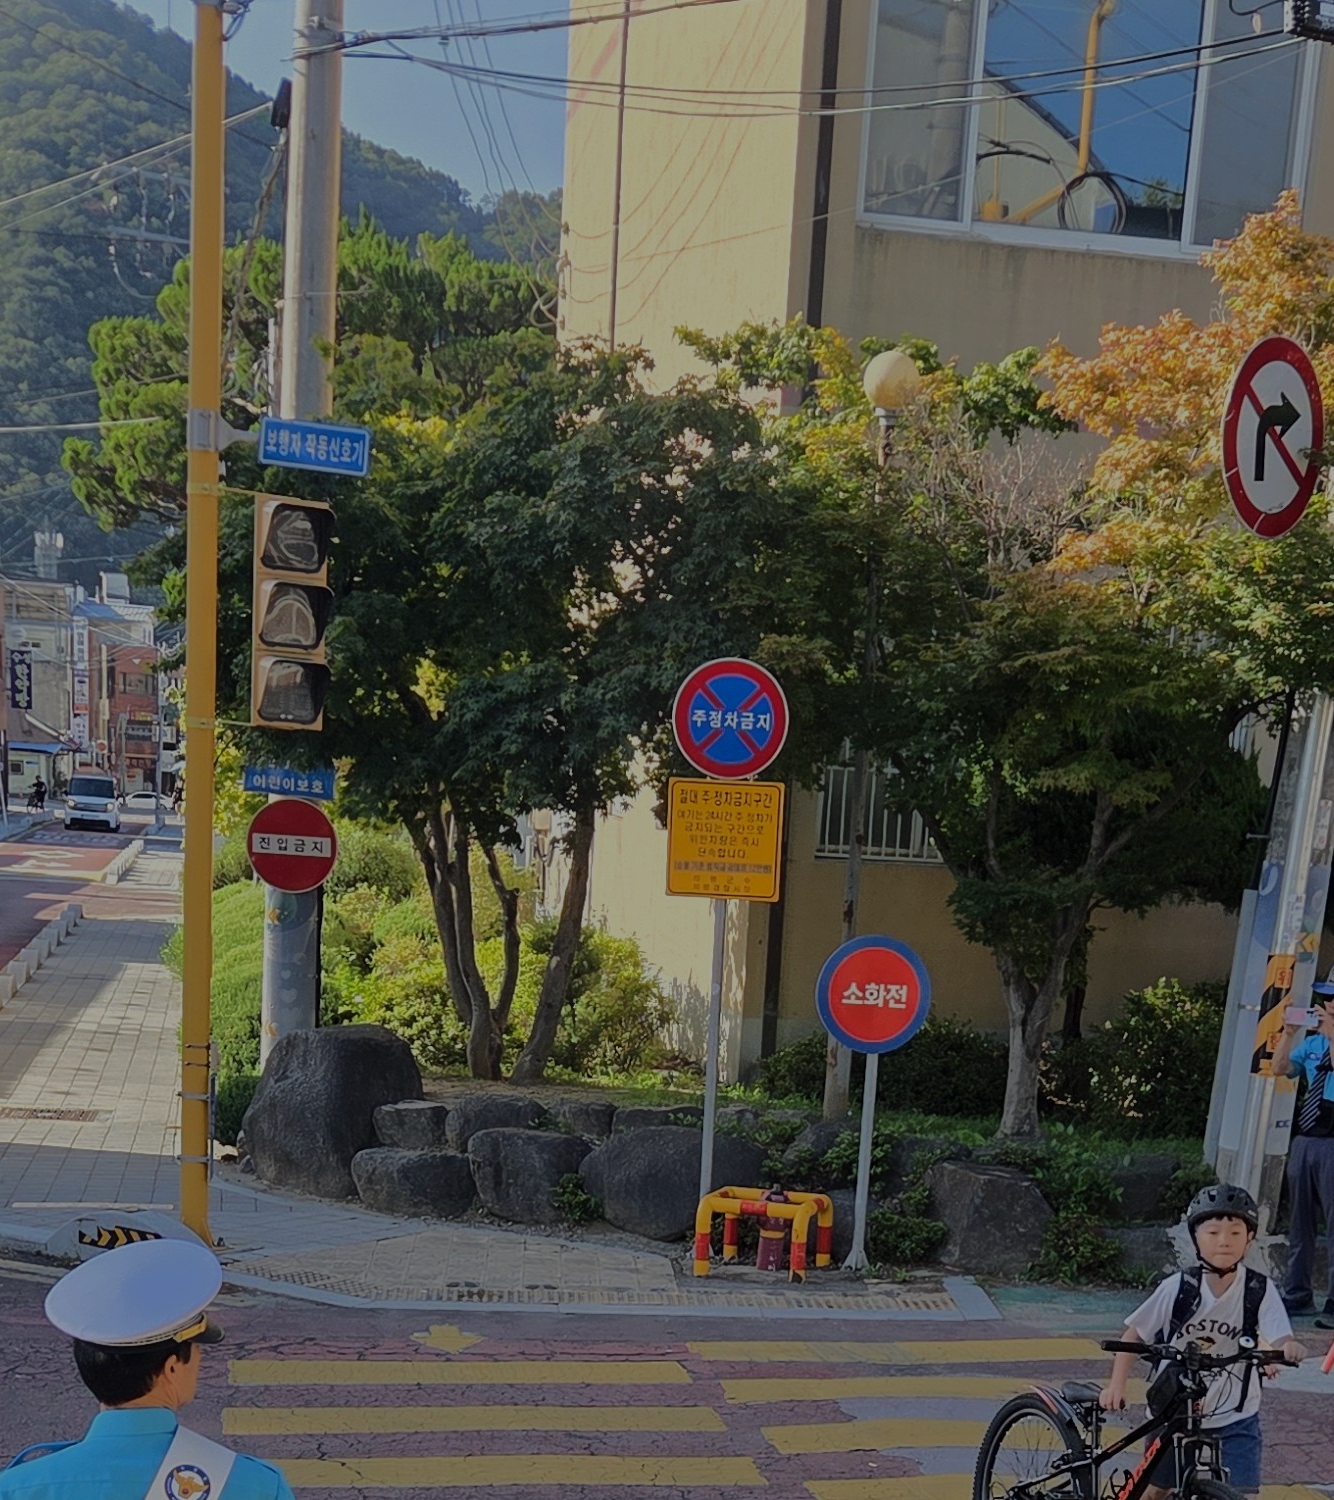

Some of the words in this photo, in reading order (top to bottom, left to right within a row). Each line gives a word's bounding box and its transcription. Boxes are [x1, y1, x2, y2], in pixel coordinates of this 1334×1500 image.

[265, 429, 302, 458] 보행자
[305, 433, 365, 466] 작동신호기
[692, 708, 771, 732] 주정차금지
[252, 774, 324, 794] 어린이보호
[259, 836, 323, 854] 진입금지
[841, 982, 908, 1009] 소화전
